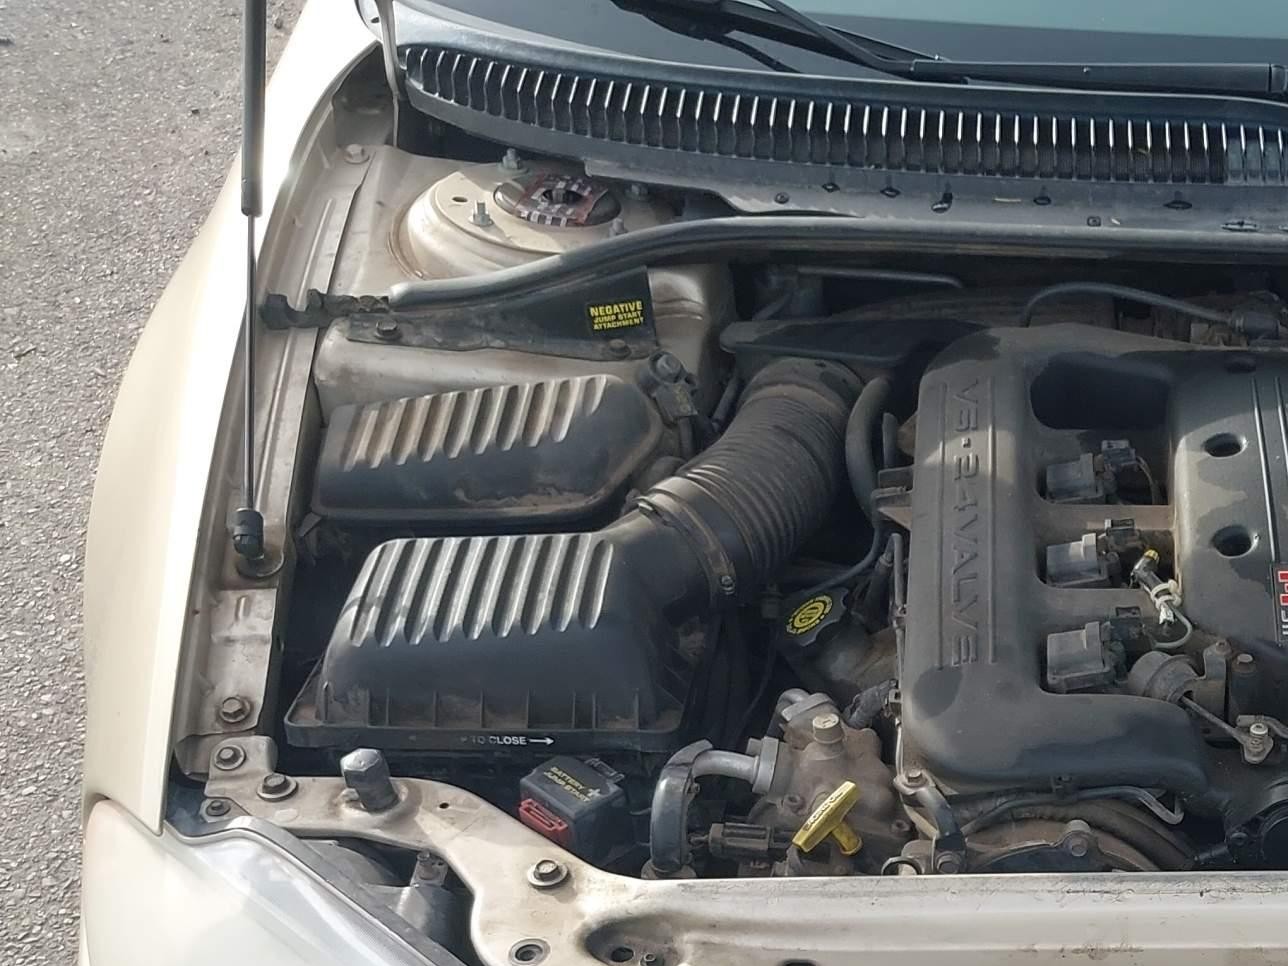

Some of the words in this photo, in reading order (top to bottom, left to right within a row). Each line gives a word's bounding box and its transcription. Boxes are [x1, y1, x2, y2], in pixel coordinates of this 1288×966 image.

[590, 301, 642, 317] NEGATIVE
[618, 311, 641, 321] START
[594, 317, 644, 330] ATTACHMENT
[489, 736, 527, 745] CLOSE
[550, 766, 584, 790] BATTERY
